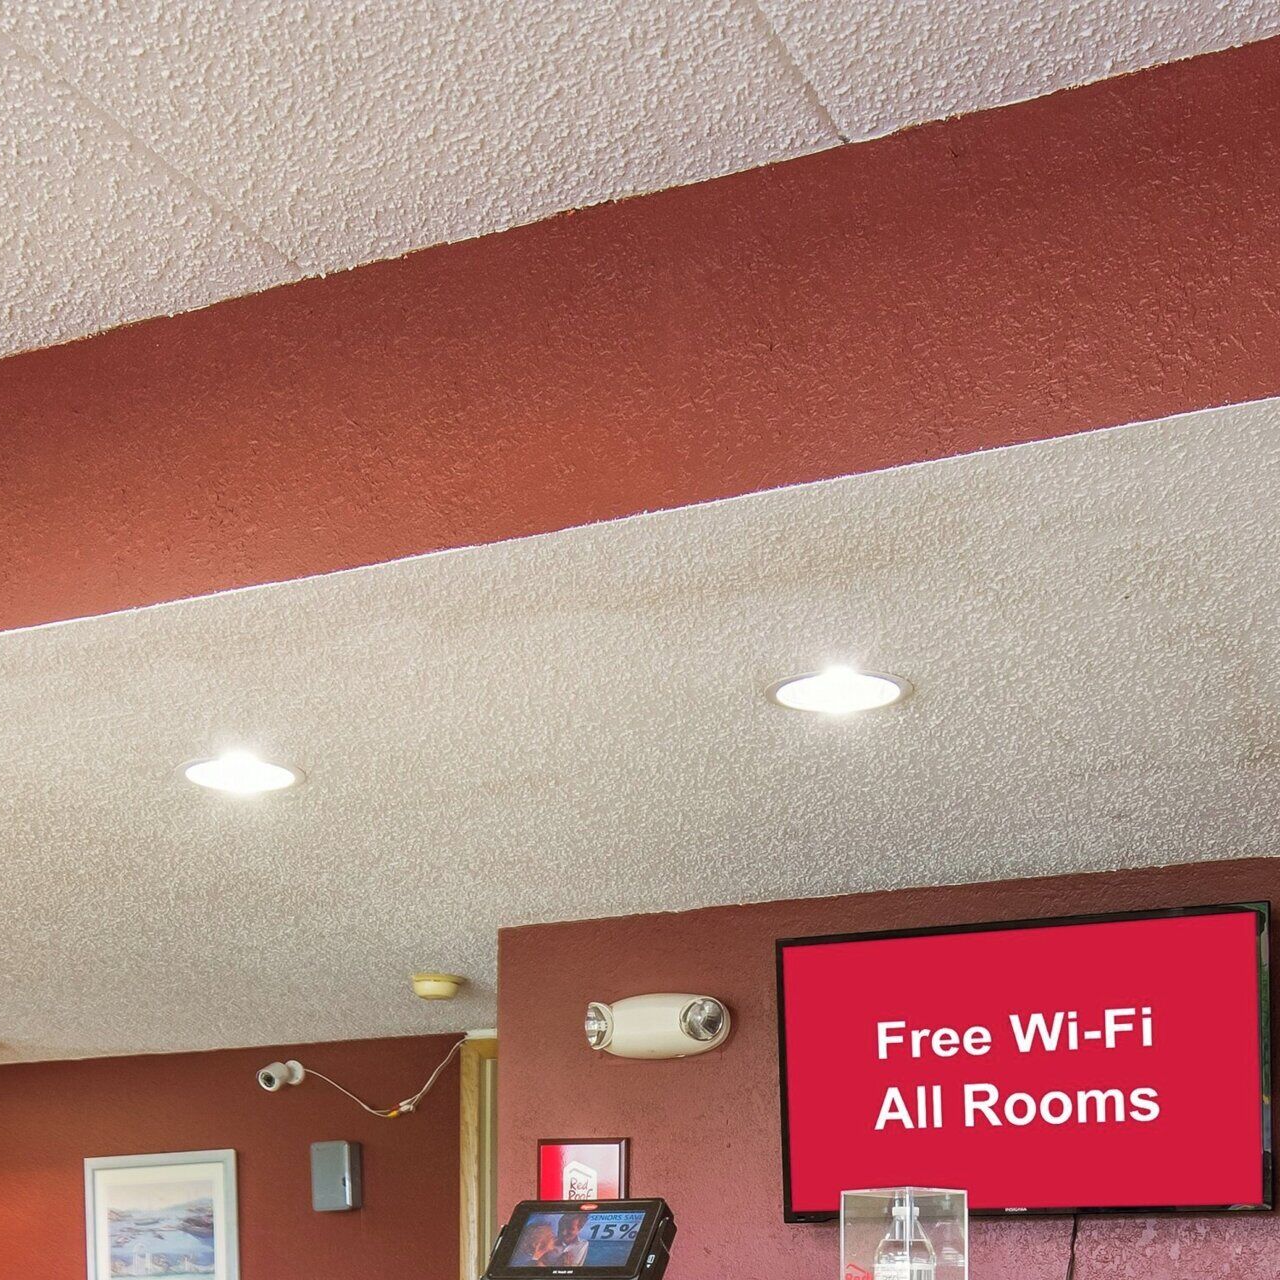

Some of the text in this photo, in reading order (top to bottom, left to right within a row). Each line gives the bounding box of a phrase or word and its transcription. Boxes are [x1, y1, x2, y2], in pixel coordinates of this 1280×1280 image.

[877, 1006, 1153, 1060] Free Wi-Fi
[874, 1082, 1161, 1130] All Rooms
[570, 1177, 589, 1190] Red
